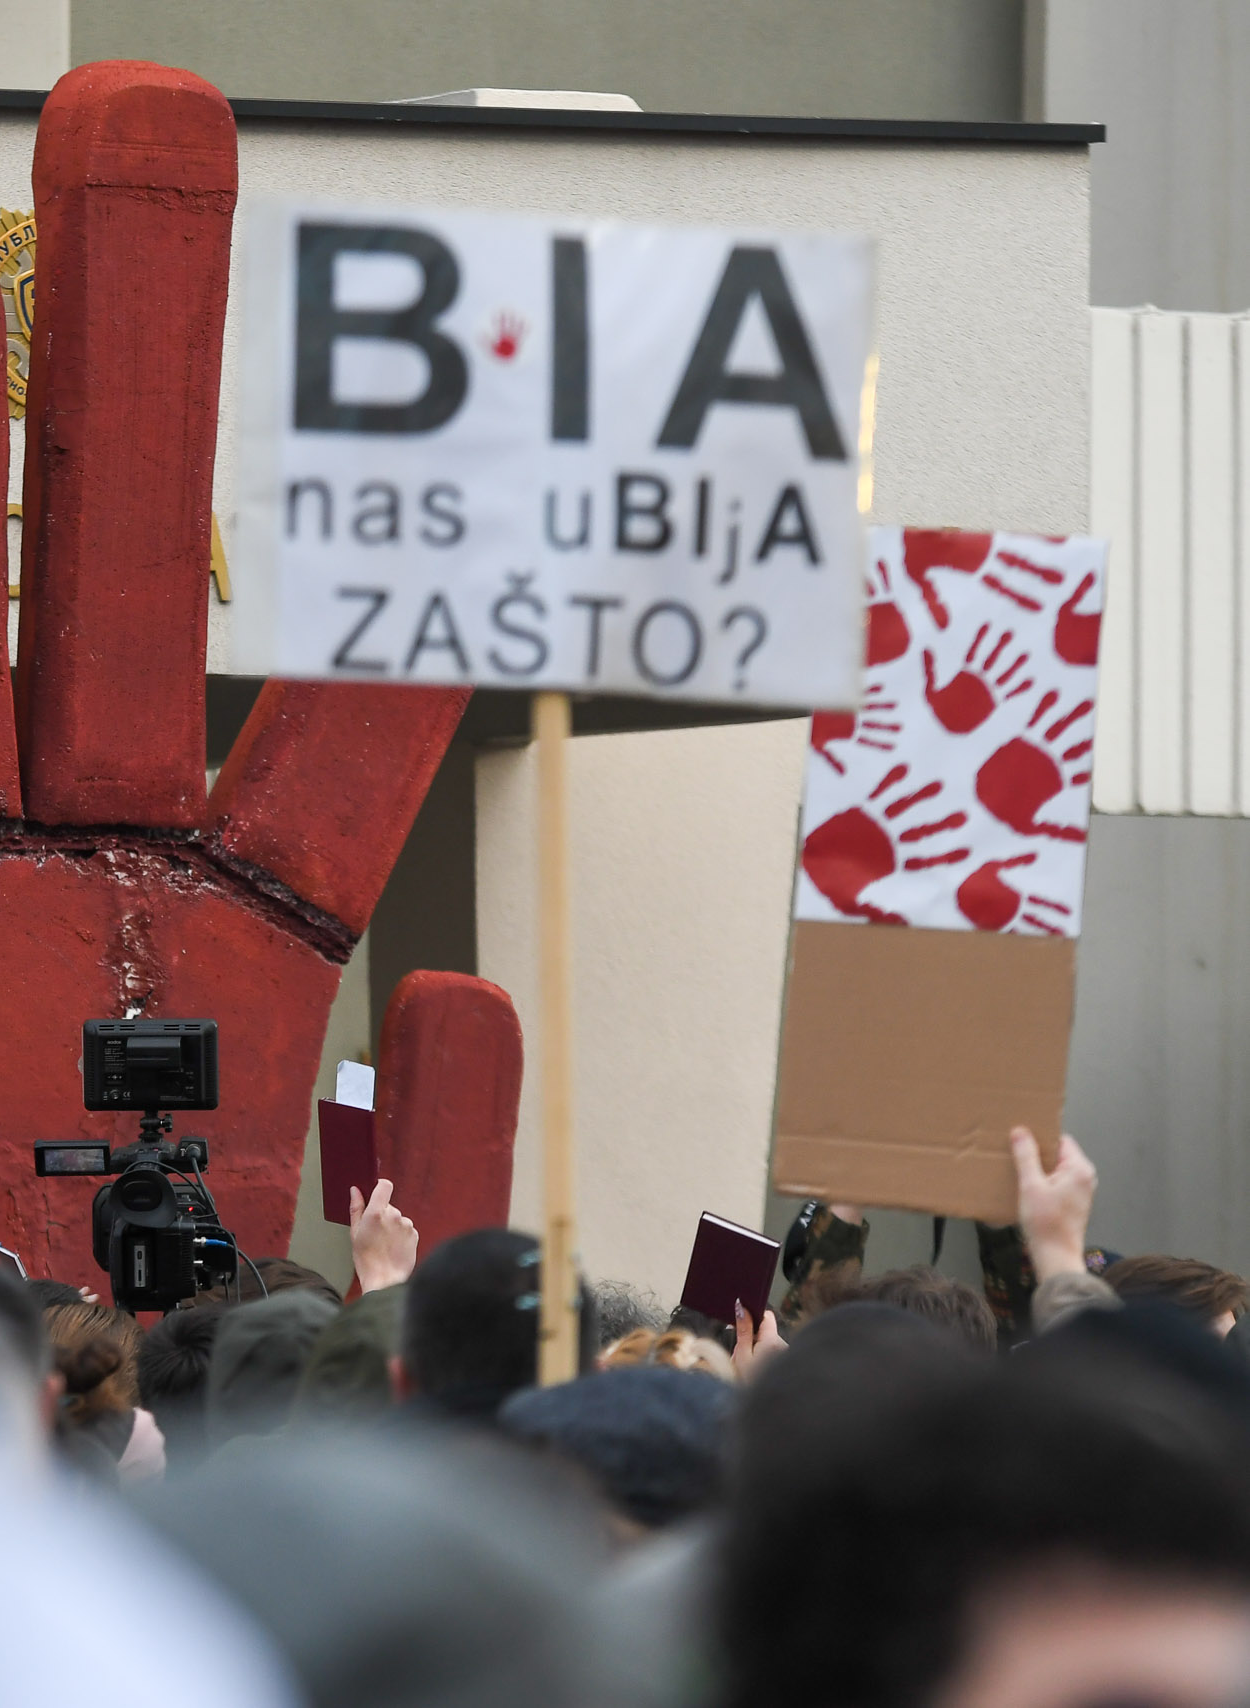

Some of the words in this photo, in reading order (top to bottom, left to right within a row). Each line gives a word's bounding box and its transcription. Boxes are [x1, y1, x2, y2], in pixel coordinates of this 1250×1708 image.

[292, 220, 851, 463] BIA
[284, 475, 467, 548] nas
[543, 470, 822, 586] uBIjA
[330, 569, 769, 690] ZAŠTO?
